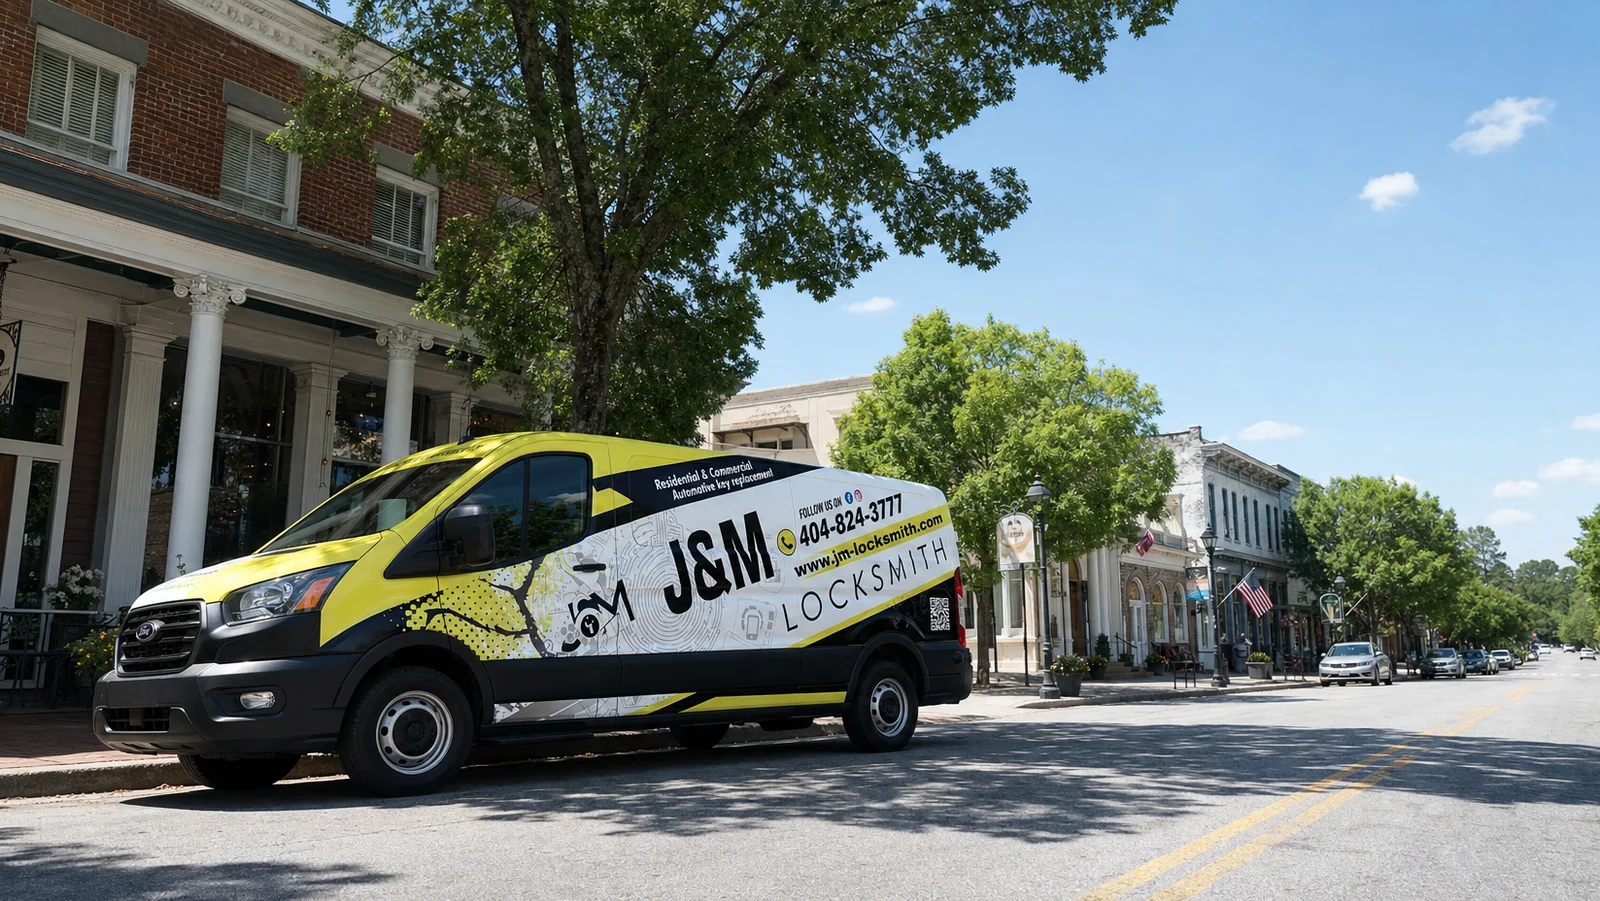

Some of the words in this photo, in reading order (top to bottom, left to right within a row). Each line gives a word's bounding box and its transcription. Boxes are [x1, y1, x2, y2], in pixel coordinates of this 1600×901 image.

[654, 470, 700, 490] Residential
[701, 469, 708, 480] &
[709, 460, 753, 478] Commercial
[672, 482, 716, 500] Automotive
[716, 479, 731, 490] key
[731, 467, 774, 487] replacement
[799, 502, 824, 519] FOLLOW
[824, 499, 833, 510] US
[833, 496, 843, 508] ON
[800, 493, 902, 547] 404-824-3777
[663, 510, 775, 614] J&M
[794, 514, 943, 577] www.jm-locksmith.com
[782, 537, 948, 631] LOCKSMITH
